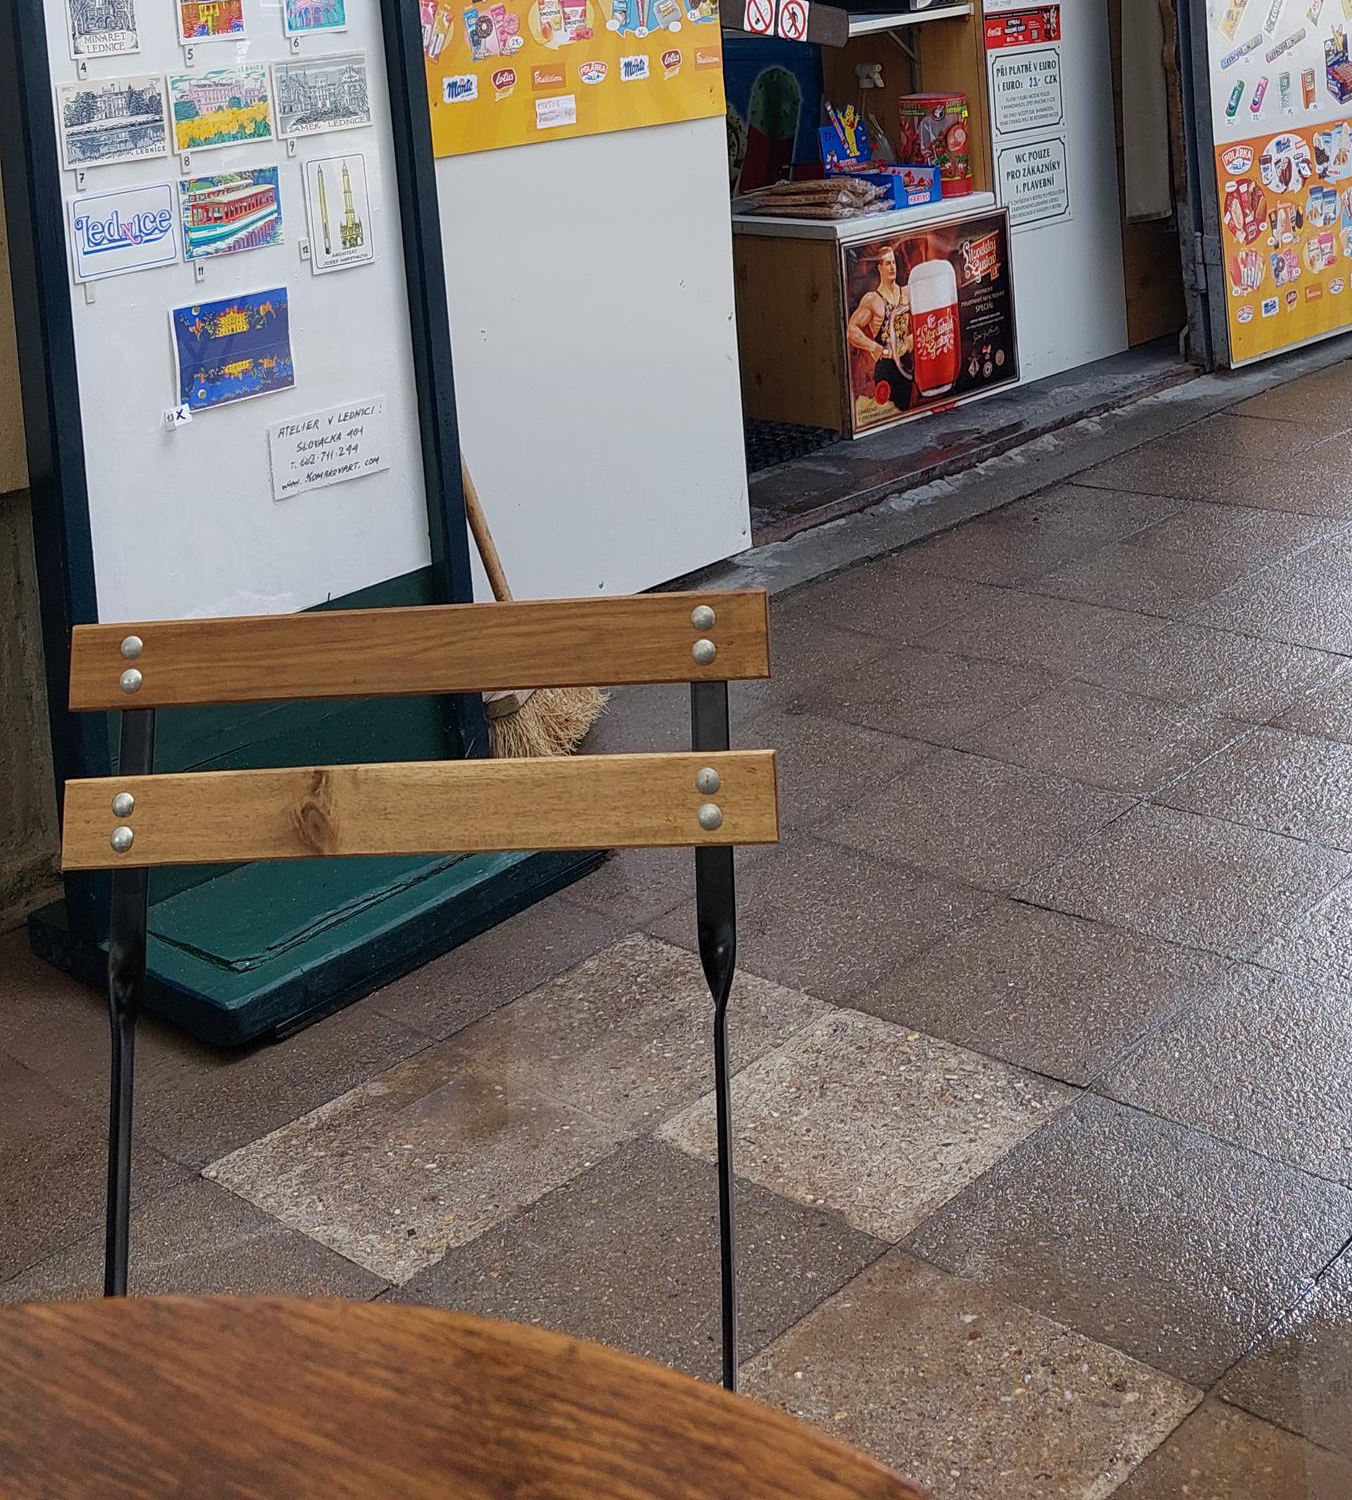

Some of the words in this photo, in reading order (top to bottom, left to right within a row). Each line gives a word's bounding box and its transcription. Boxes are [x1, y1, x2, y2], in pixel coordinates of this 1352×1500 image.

[84, 31, 127, 45] MINARET
[86, 42, 126, 54] LEDNICE
[995, 63, 1008, 79] PŘI
[1009, 60, 1032, 77] PLATBĚ
[1039, 60, 1057, 72] EURO
[446, 79, 474, 100] Monte
[1002, 78, 1023, 91] EURO:
[1044, 74, 1058, 86] CZK
[327, 116, 366, 128] LEDNICE
[1014, 152, 1027, 165] WC
[1028, 148, 1050, 162] POUZE
[1006, 168, 1021, 182] PRO
[1022, 159, 1061, 179] ZÁKAZNÍKY
[1023, 175, 1055, 193] PLAVEBNÍ
[327, 415, 334, 426] V
